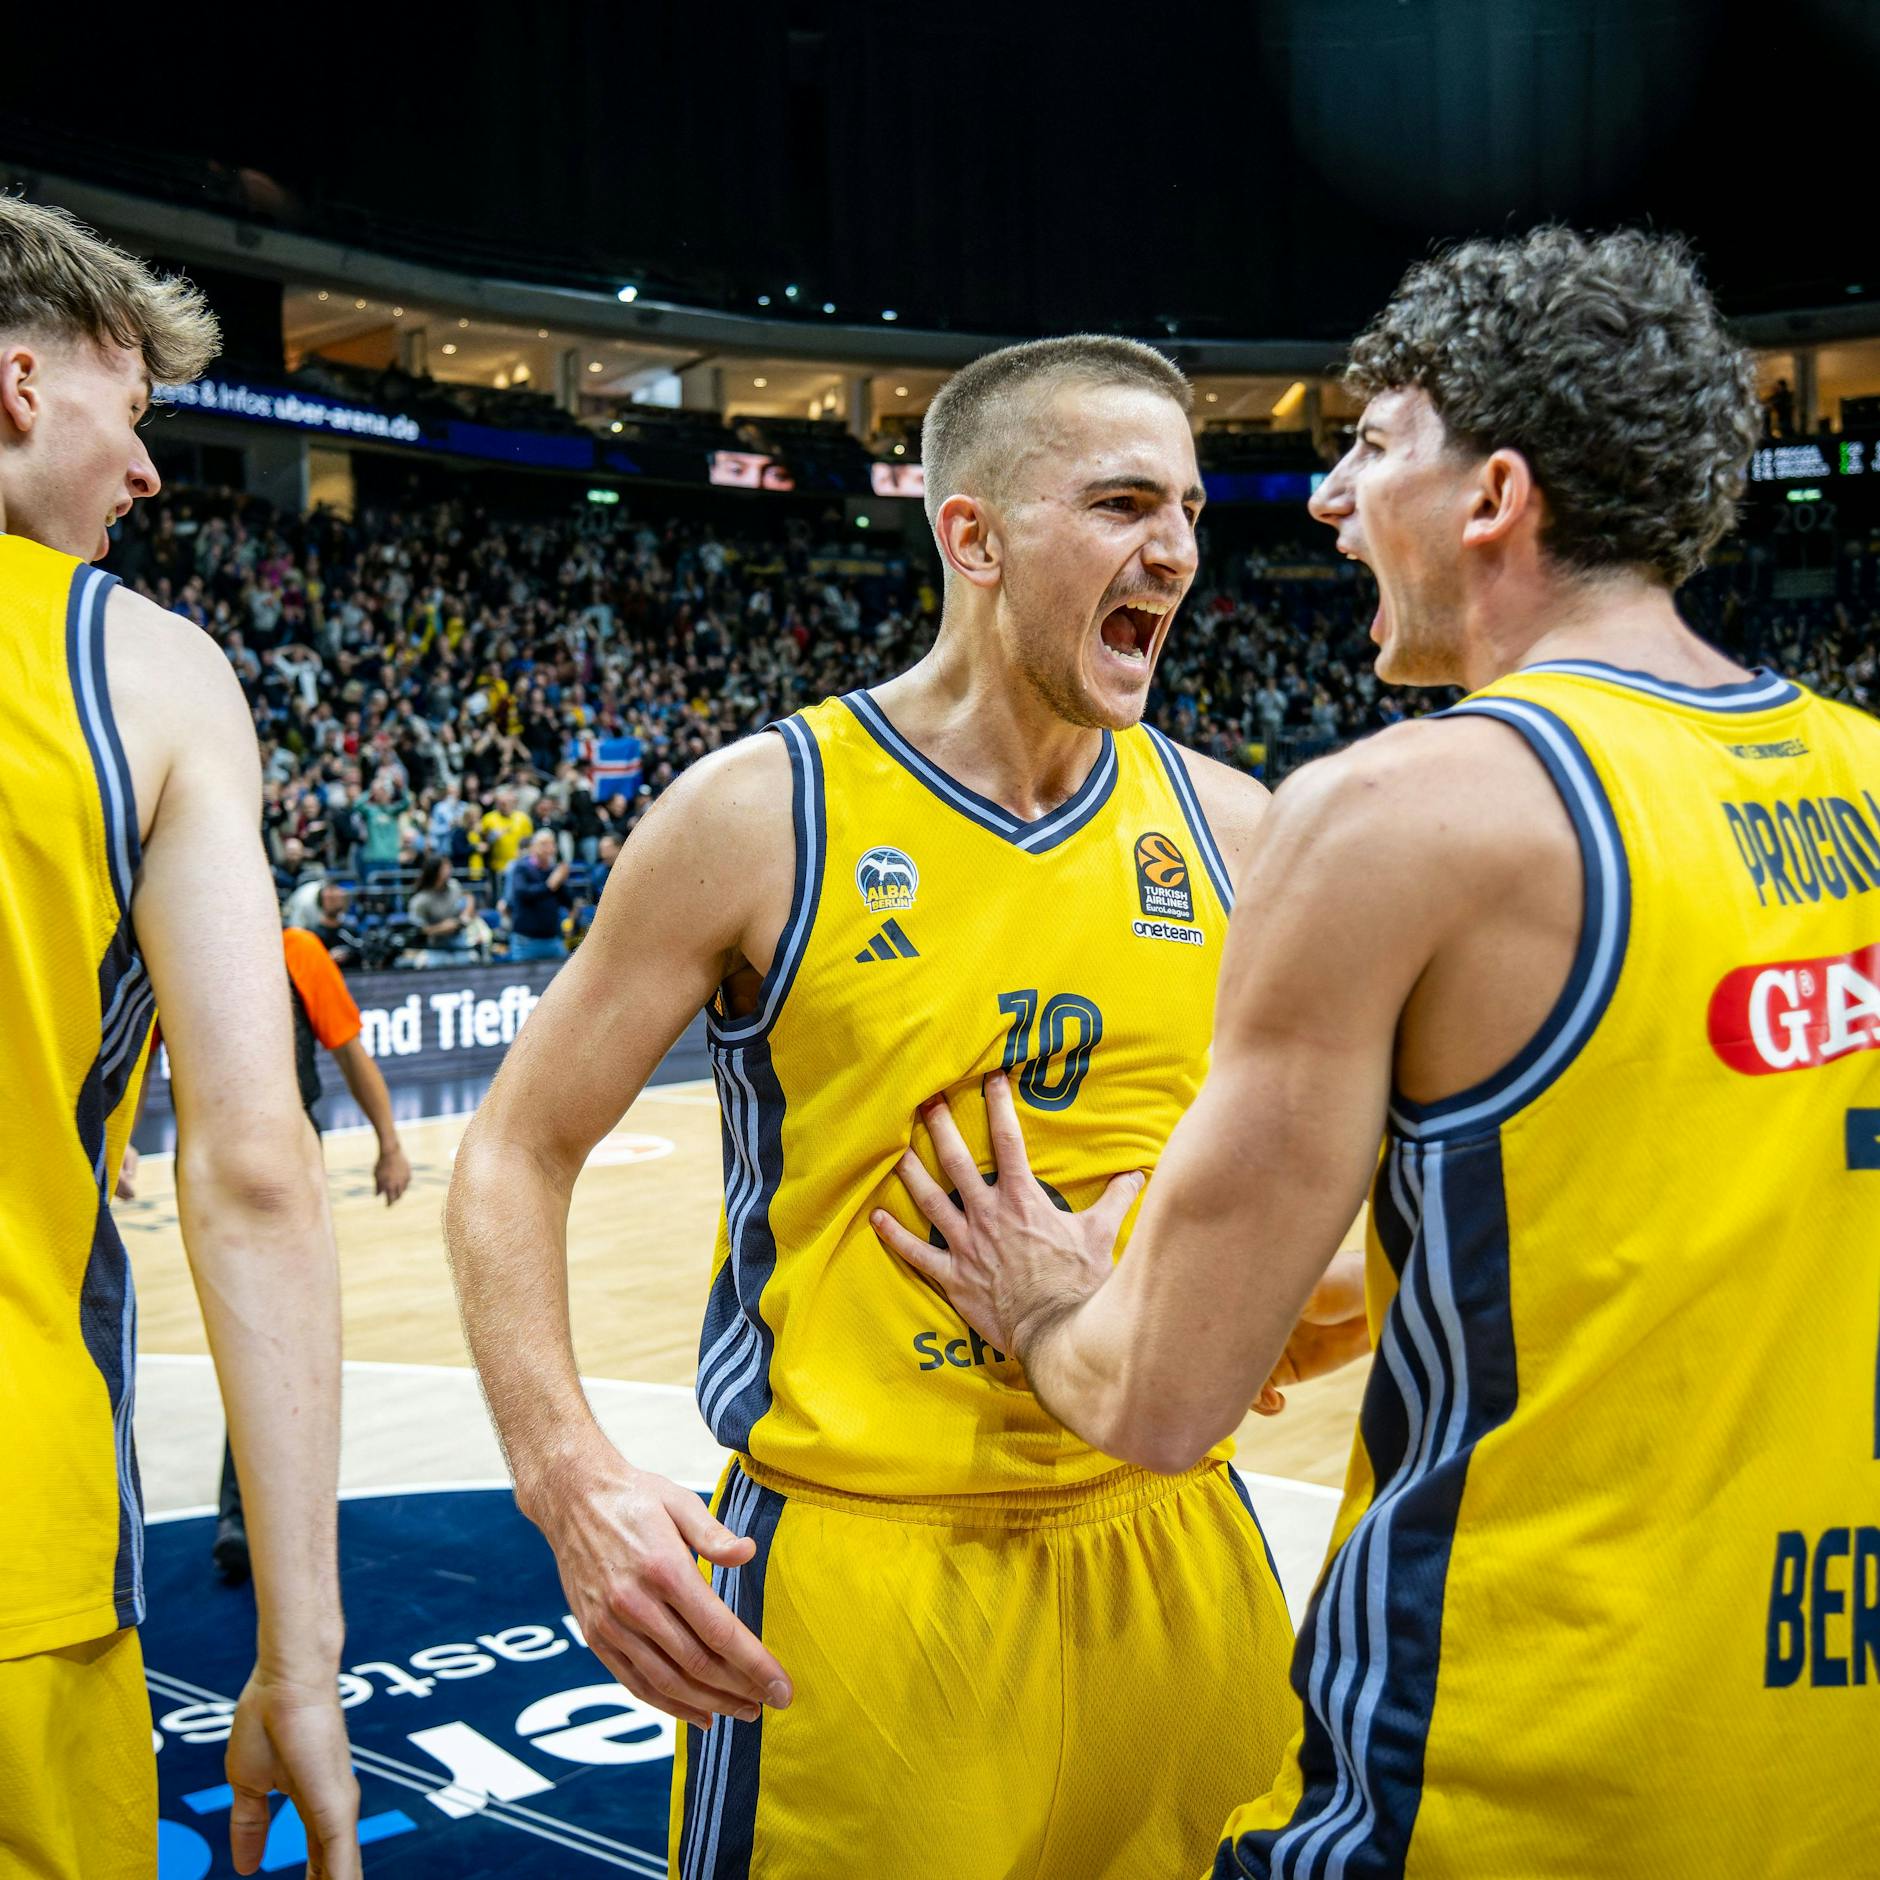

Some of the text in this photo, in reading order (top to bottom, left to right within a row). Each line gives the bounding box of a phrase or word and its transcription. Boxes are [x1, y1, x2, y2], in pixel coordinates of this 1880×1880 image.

[274, 394, 420, 441] uber-arena.de
[1721, 789, 1880, 907] PROCID
[867, 885, 911, 902] ALBA
[871, 898, 909, 910] BERLIN
[1144, 886, 1188, 900] TURKISH
[1146, 894, 1189, 910] AIRLINES
[1146, 904, 1190, 917] EuroLeague
[1134, 922, 1203, 944] oneteam
[359, 995, 421, 1057] nd
[987, 989, 1102, 1111] 10
[913, 1327, 1014, 1371] Sch
